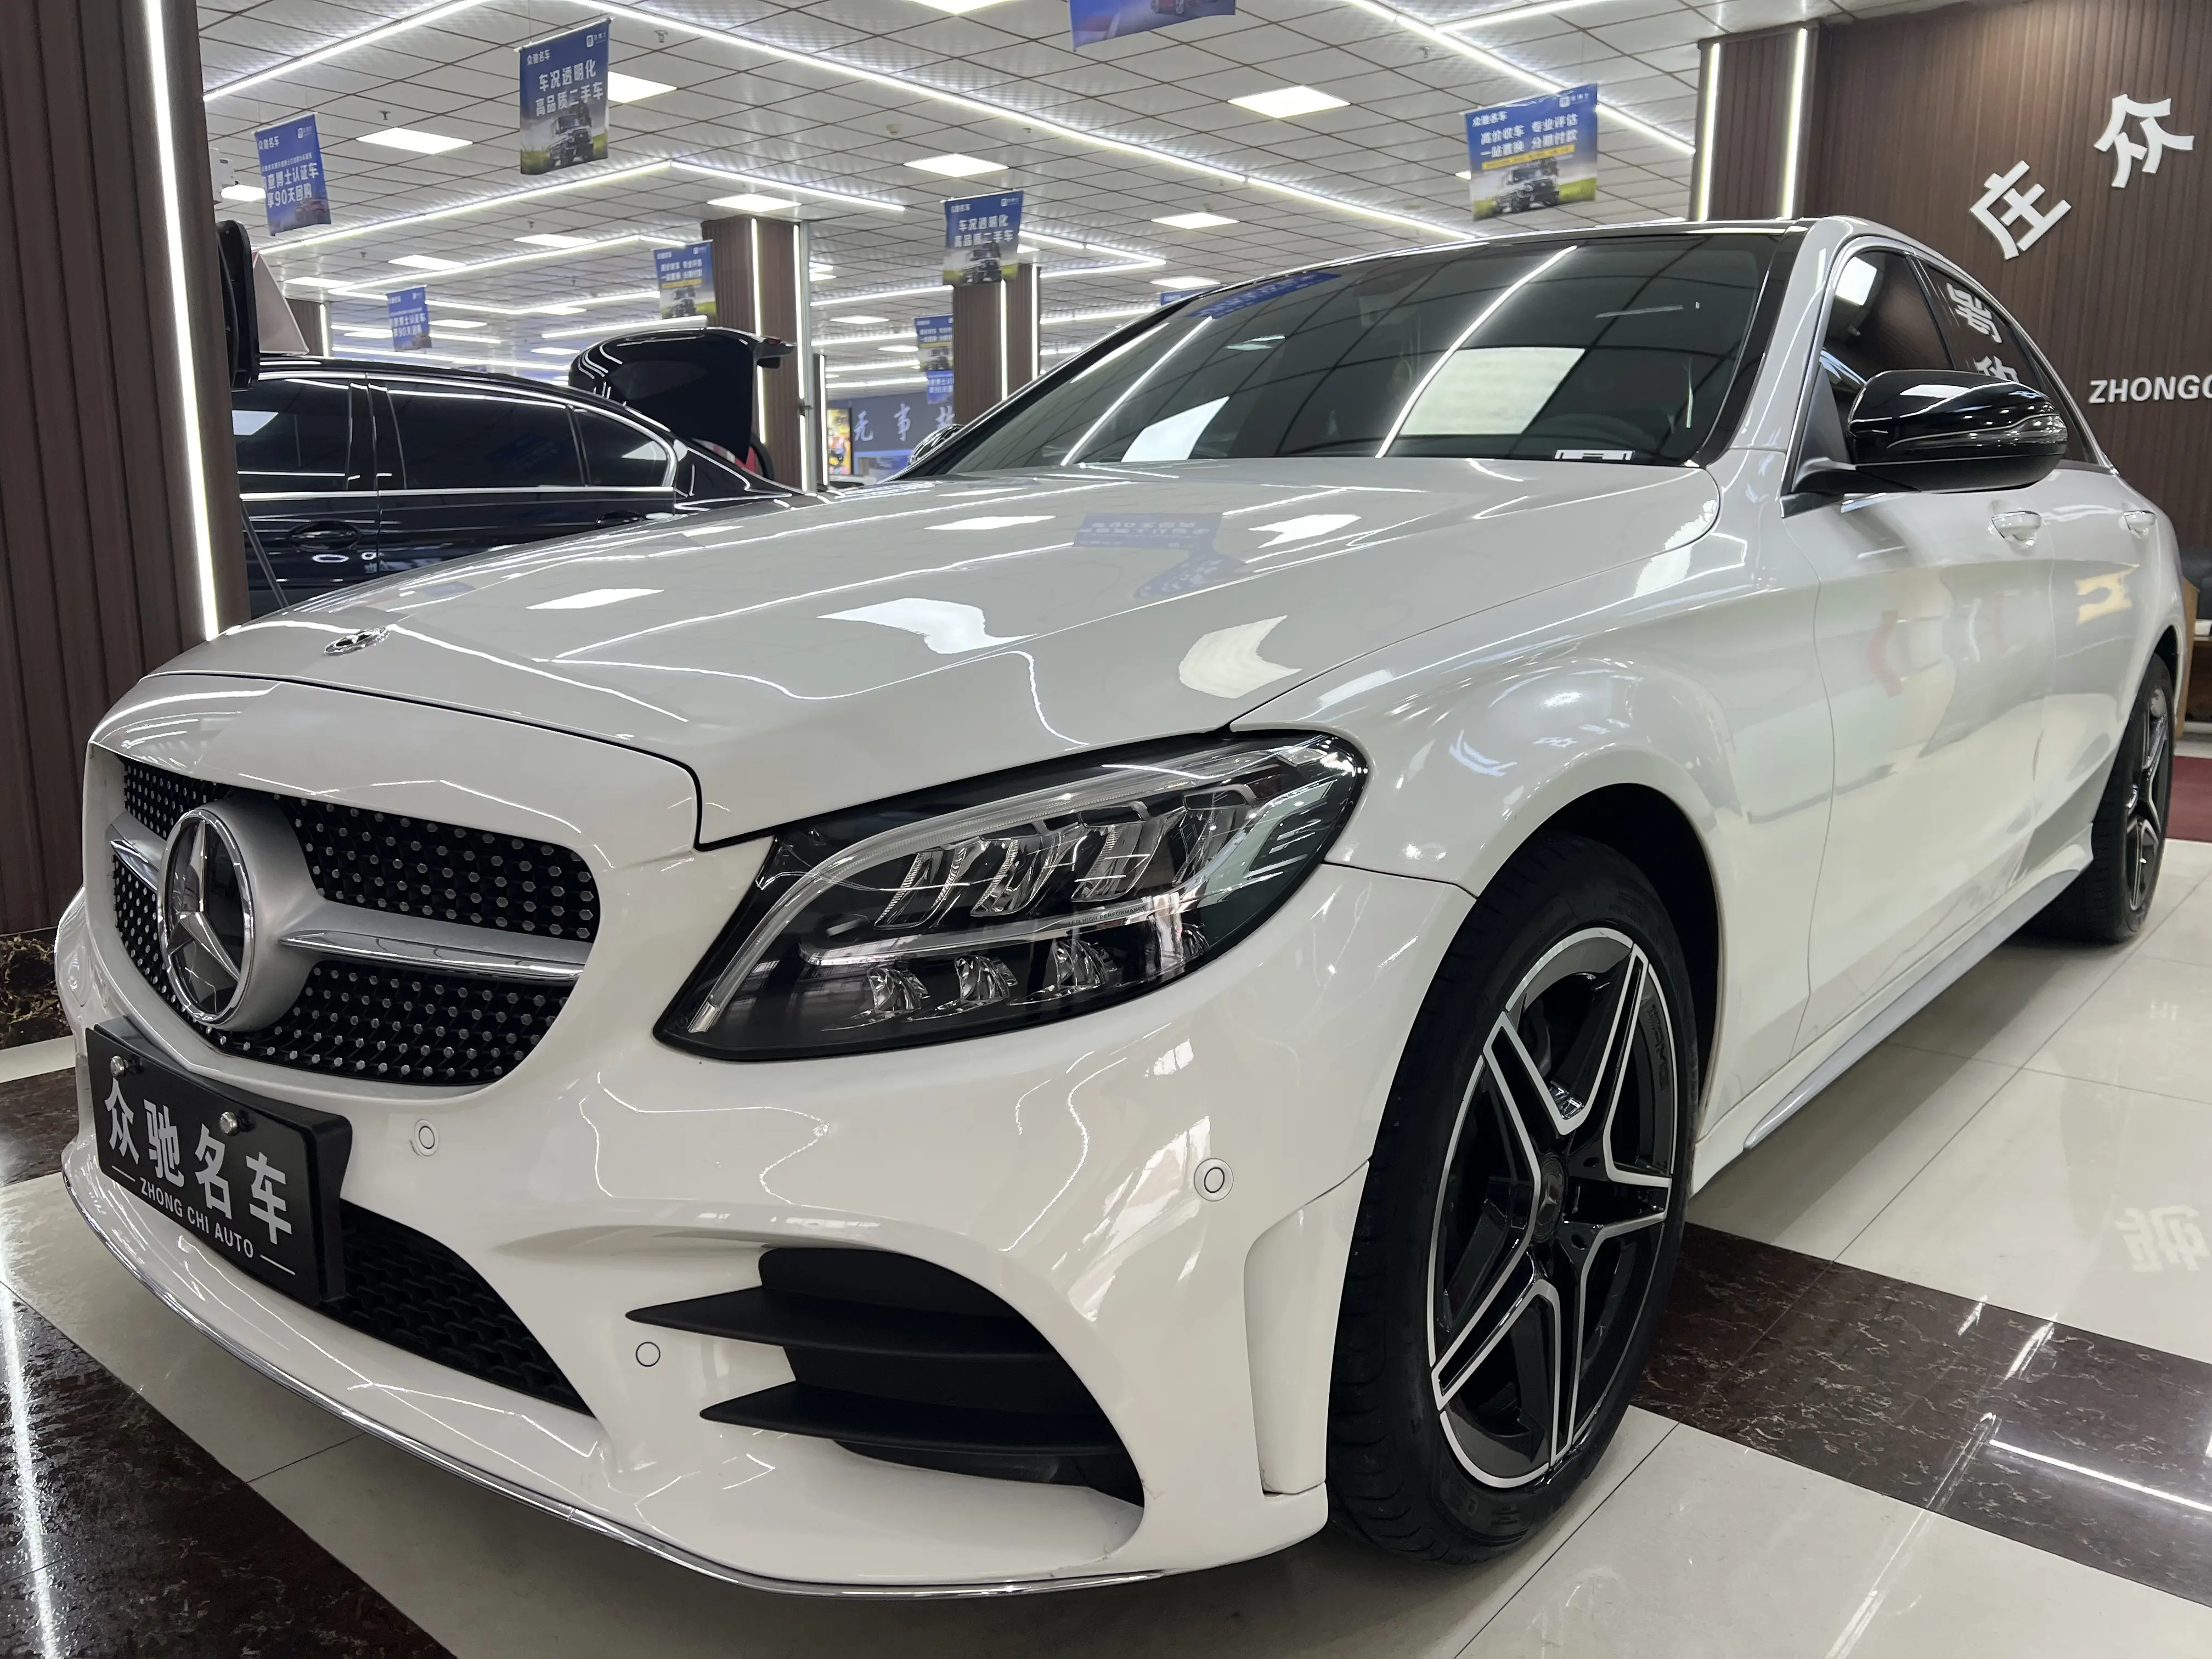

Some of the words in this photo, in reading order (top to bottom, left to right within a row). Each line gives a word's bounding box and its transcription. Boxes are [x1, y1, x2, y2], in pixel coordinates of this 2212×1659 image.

[527, 49, 551, 66] 众驰名车
[539, 59, 596, 92] 车况透明化
[535, 81, 604, 117] 高品质二手车
[1472, 111, 1508, 127] 众驰名车
[1481, 125, 1525, 145] 高价收车
[1531, 112, 1578, 133] 专业评估
[1480, 140, 1525, 158] 一站置换
[1531, 129, 1578, 149] 分期付款
[267, 182, 312, 208] 享90天回购
[958, 214, 1009, 232] 车况透明化
[953, 229, 1014, 247] 高品质二手车
[1082, 916, 1098, 924] HIGH
[1099, 905, 1147, 920] PERFORMANCE
[104, 1077, 293, 1245] 众驰名车
[140, 1176, 183, 1218] ZHONG
[187, 1206, 210, 1234] CHI
[215, 1222, 254, 1259] AUTO
